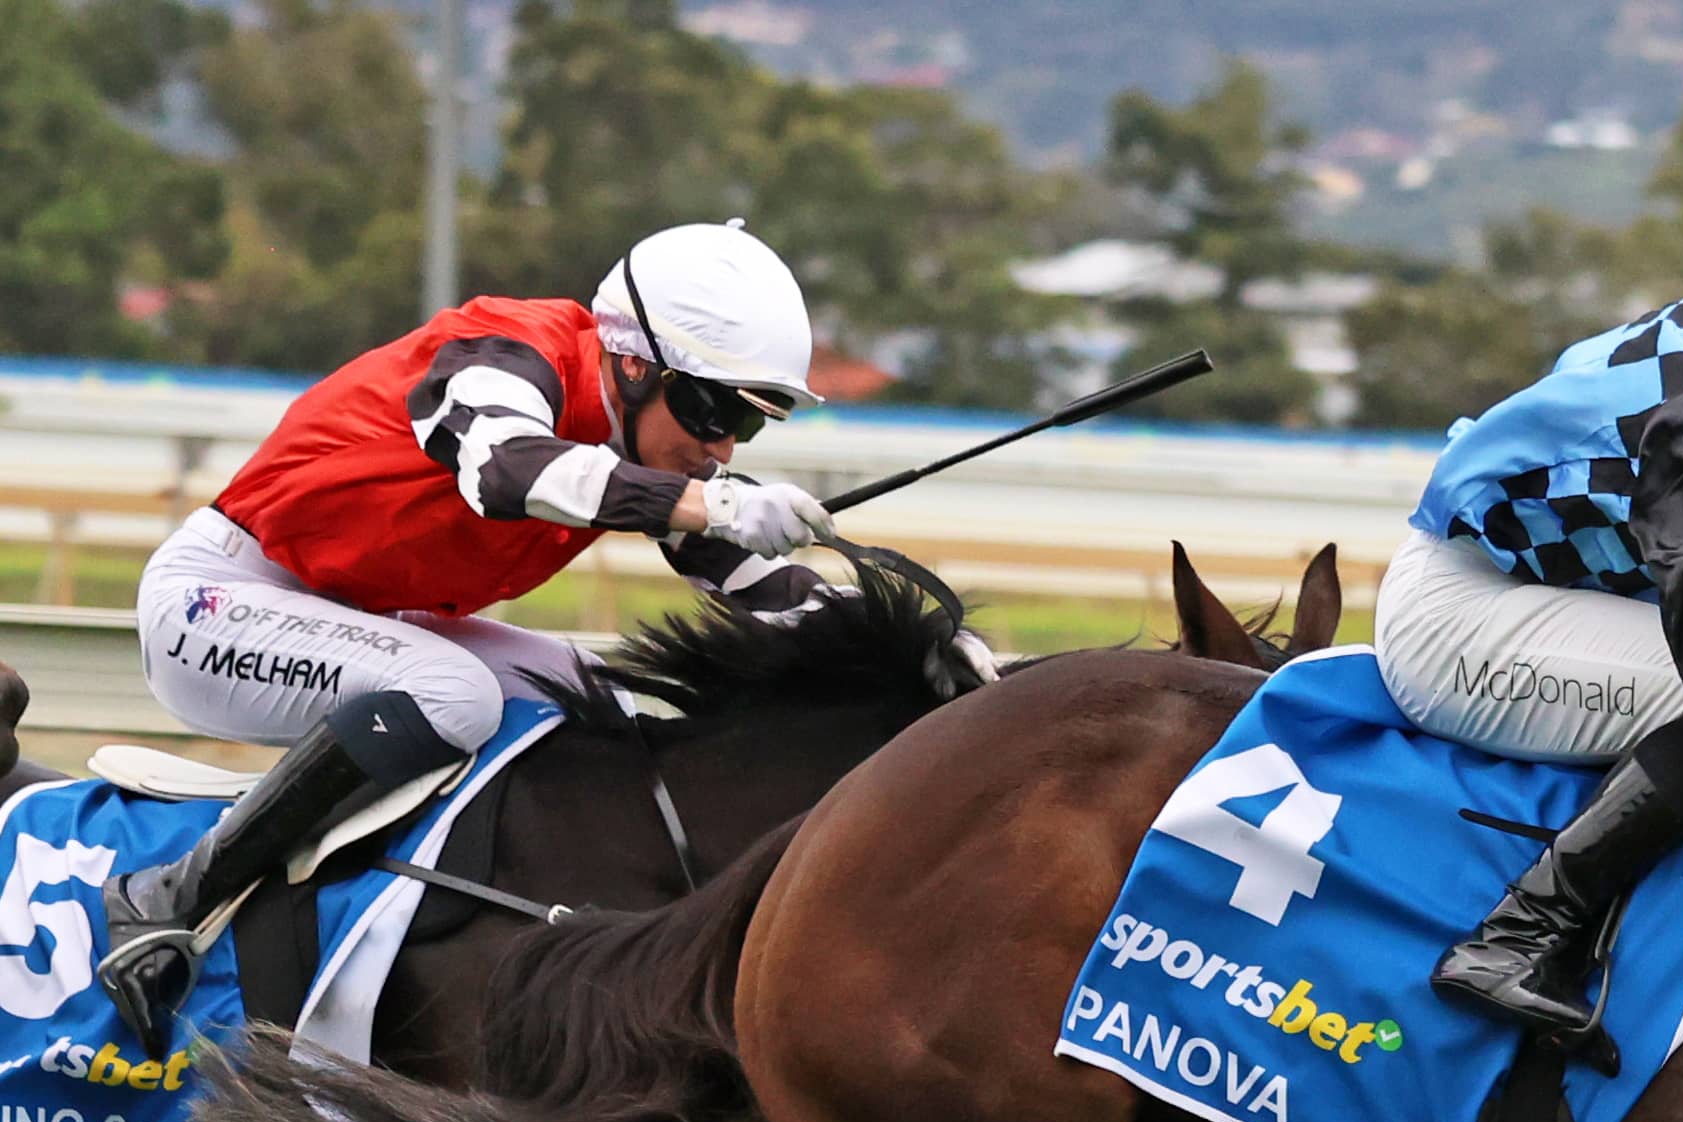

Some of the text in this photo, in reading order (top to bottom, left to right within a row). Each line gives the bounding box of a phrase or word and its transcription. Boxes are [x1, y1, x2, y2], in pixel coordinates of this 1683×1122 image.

[167, 632, 343, 694] J. MELHAM
[277, 614, 329, 637] THE
[328, 623, 412, 656] TRACK
[1454, 655, 1636, 717] McDonald
[1151, 742, 1343, 927] 4
[0, 832, 117, 1020] 5
[1100, 913, 1376, 1064] sportsbet
[0, 1036, 191, 1091] tsbet
